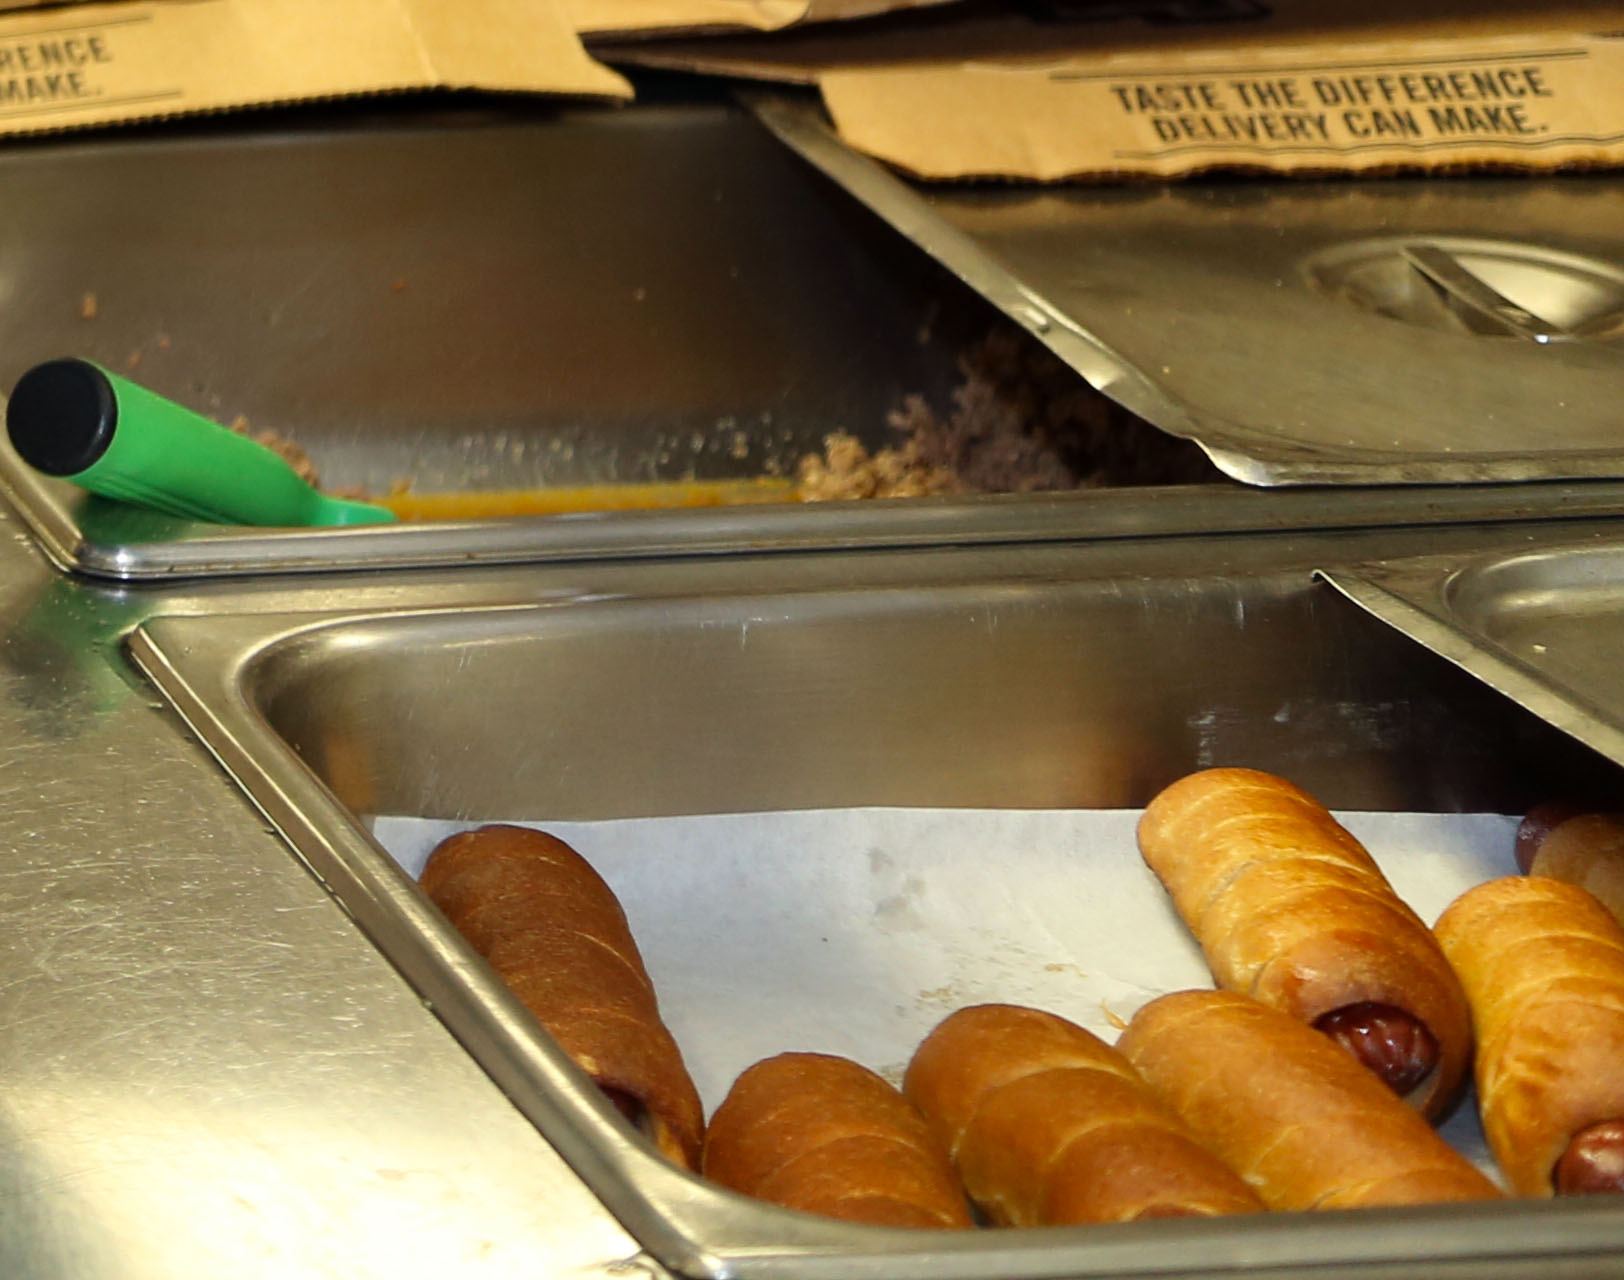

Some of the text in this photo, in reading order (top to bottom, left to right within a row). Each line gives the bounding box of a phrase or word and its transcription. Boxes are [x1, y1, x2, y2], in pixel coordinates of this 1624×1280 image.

[1112, 67, 1554, 115] TASTE THE DIFFERENCE
[1151, 103, 1549, 143] DELIVERY CAN MAKE.
